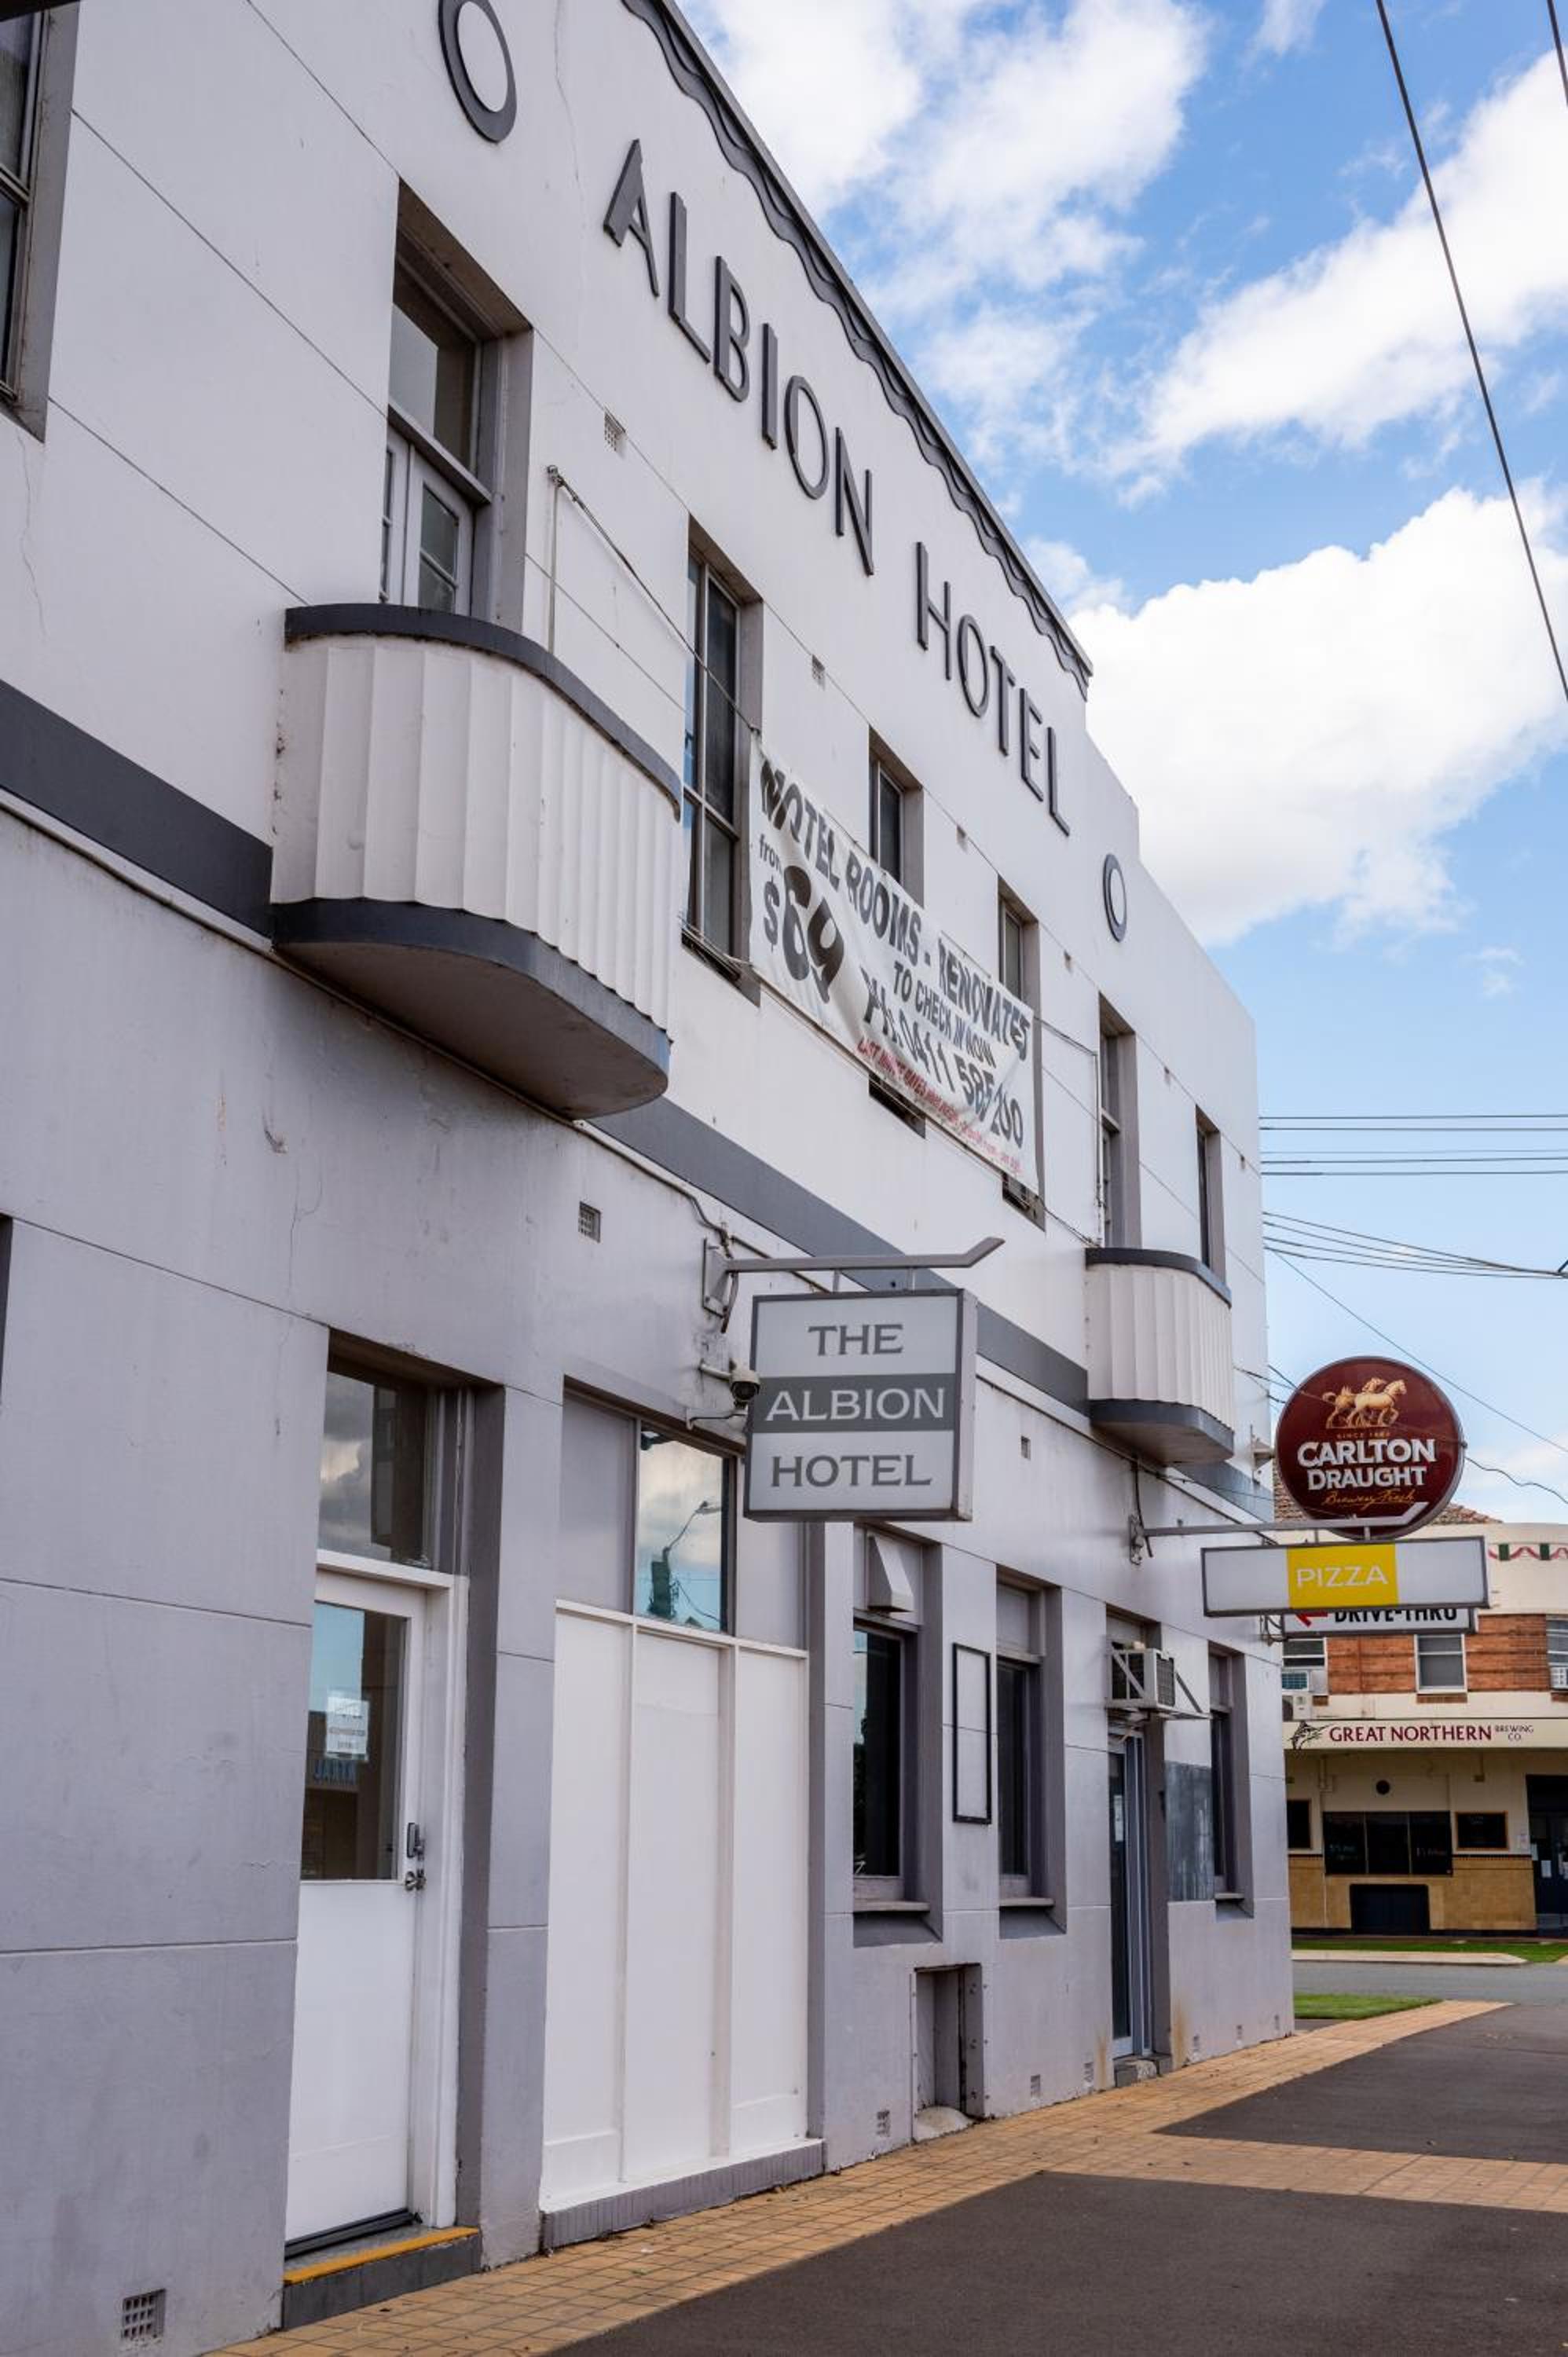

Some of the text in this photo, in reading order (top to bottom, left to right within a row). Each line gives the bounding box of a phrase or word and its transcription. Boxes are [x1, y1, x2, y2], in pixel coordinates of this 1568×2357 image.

[603, 138, 874, 576] ALBION
[916, 541, 1069, 837] HOTEL
[760, 760, 840, 892] MOTEL
[846, 851, 921, 966] ROOMS
[894, 961, 912, 1003] TO
[915, 981, 952, 1040] CHECK
[808, 1323, 903, 1357] THE
[765, 1387, 946, 1422] ALBION
[1297, 1438, 1438, 1468] CARLTON
[770, 1454, 933, 1488] HOTEL
[1307, 1465, 1427, 1490] DRAUGHT
[1296, 1564, 1389, 1588] PIZZA
[1335, 1607, 1458, 1623] DRIVE-THRU
[1329, 1725, 1492, 1742] GREAT NORTHERN
